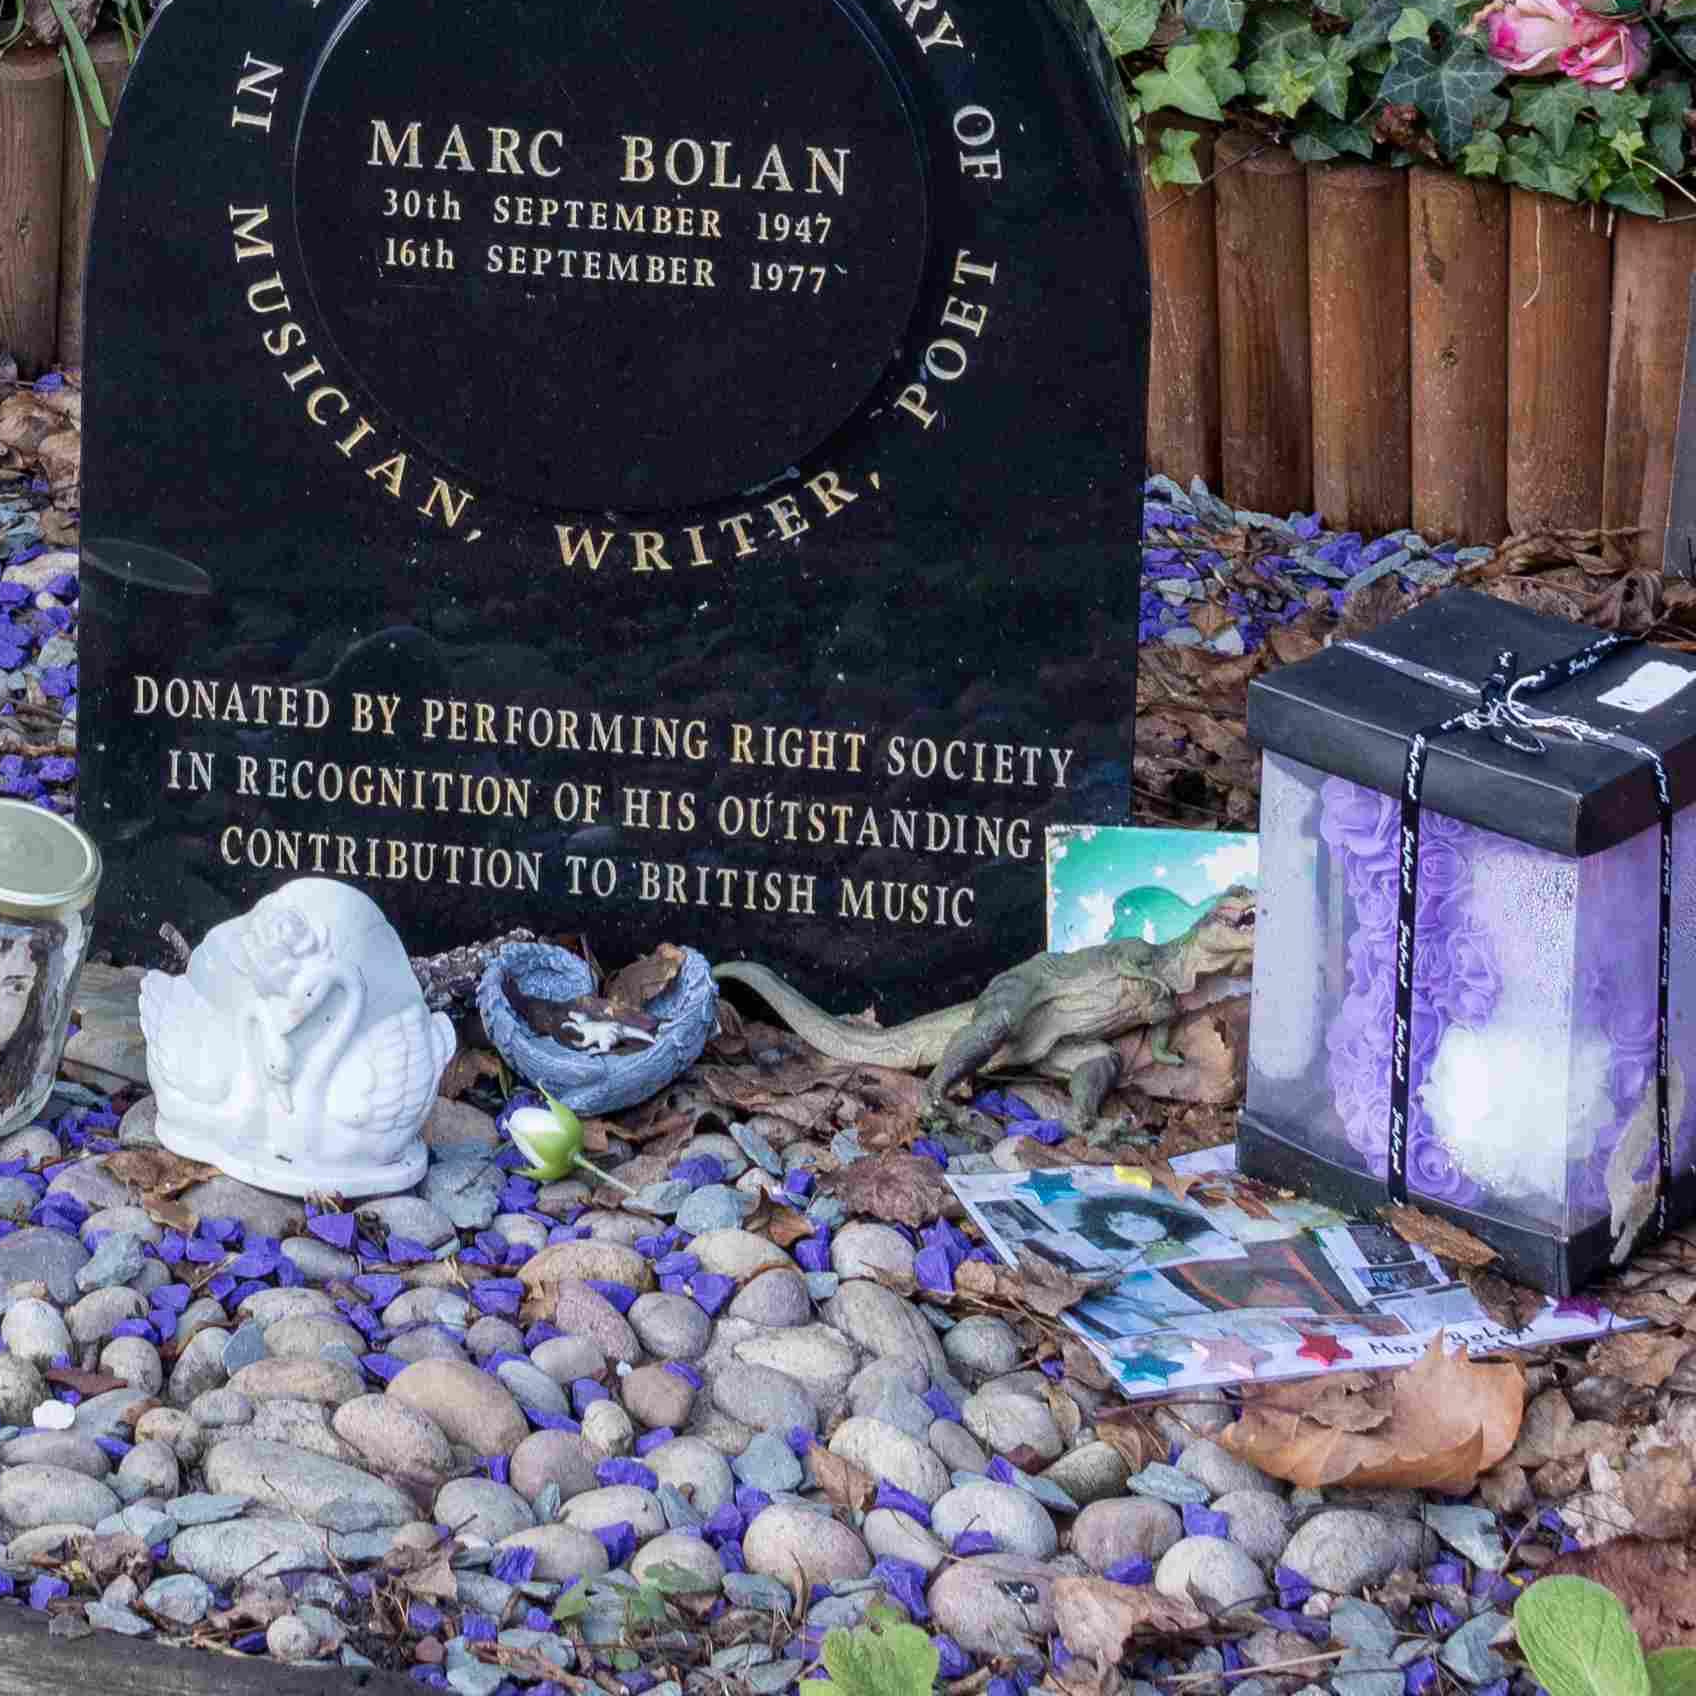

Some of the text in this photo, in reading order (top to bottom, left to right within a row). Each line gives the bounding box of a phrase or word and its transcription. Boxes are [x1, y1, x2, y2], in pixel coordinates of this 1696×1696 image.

[232, 52, 284, 134] IN
[953, 105, 1002, 181] OF
[367, 119, 851, 196] MARC BOLAN
[383, 188, 832, 245] 30th SEPTEMBER 1947
[384, 237, 827, 295] 16th SEPTEMBER 1977
[229, 203, 998, 572] MUSICIAN, WRITER, POET
[133, 675, 1073, 789] DONATED BY PERFORMING RIGHT SOCIETY
[167, 749, 1033, 859] IN RECOGNITION OF HIS OUTSTANDING
[220, 826, 977, 928] CONTRIBUTION TO BRITISH MUSIC
